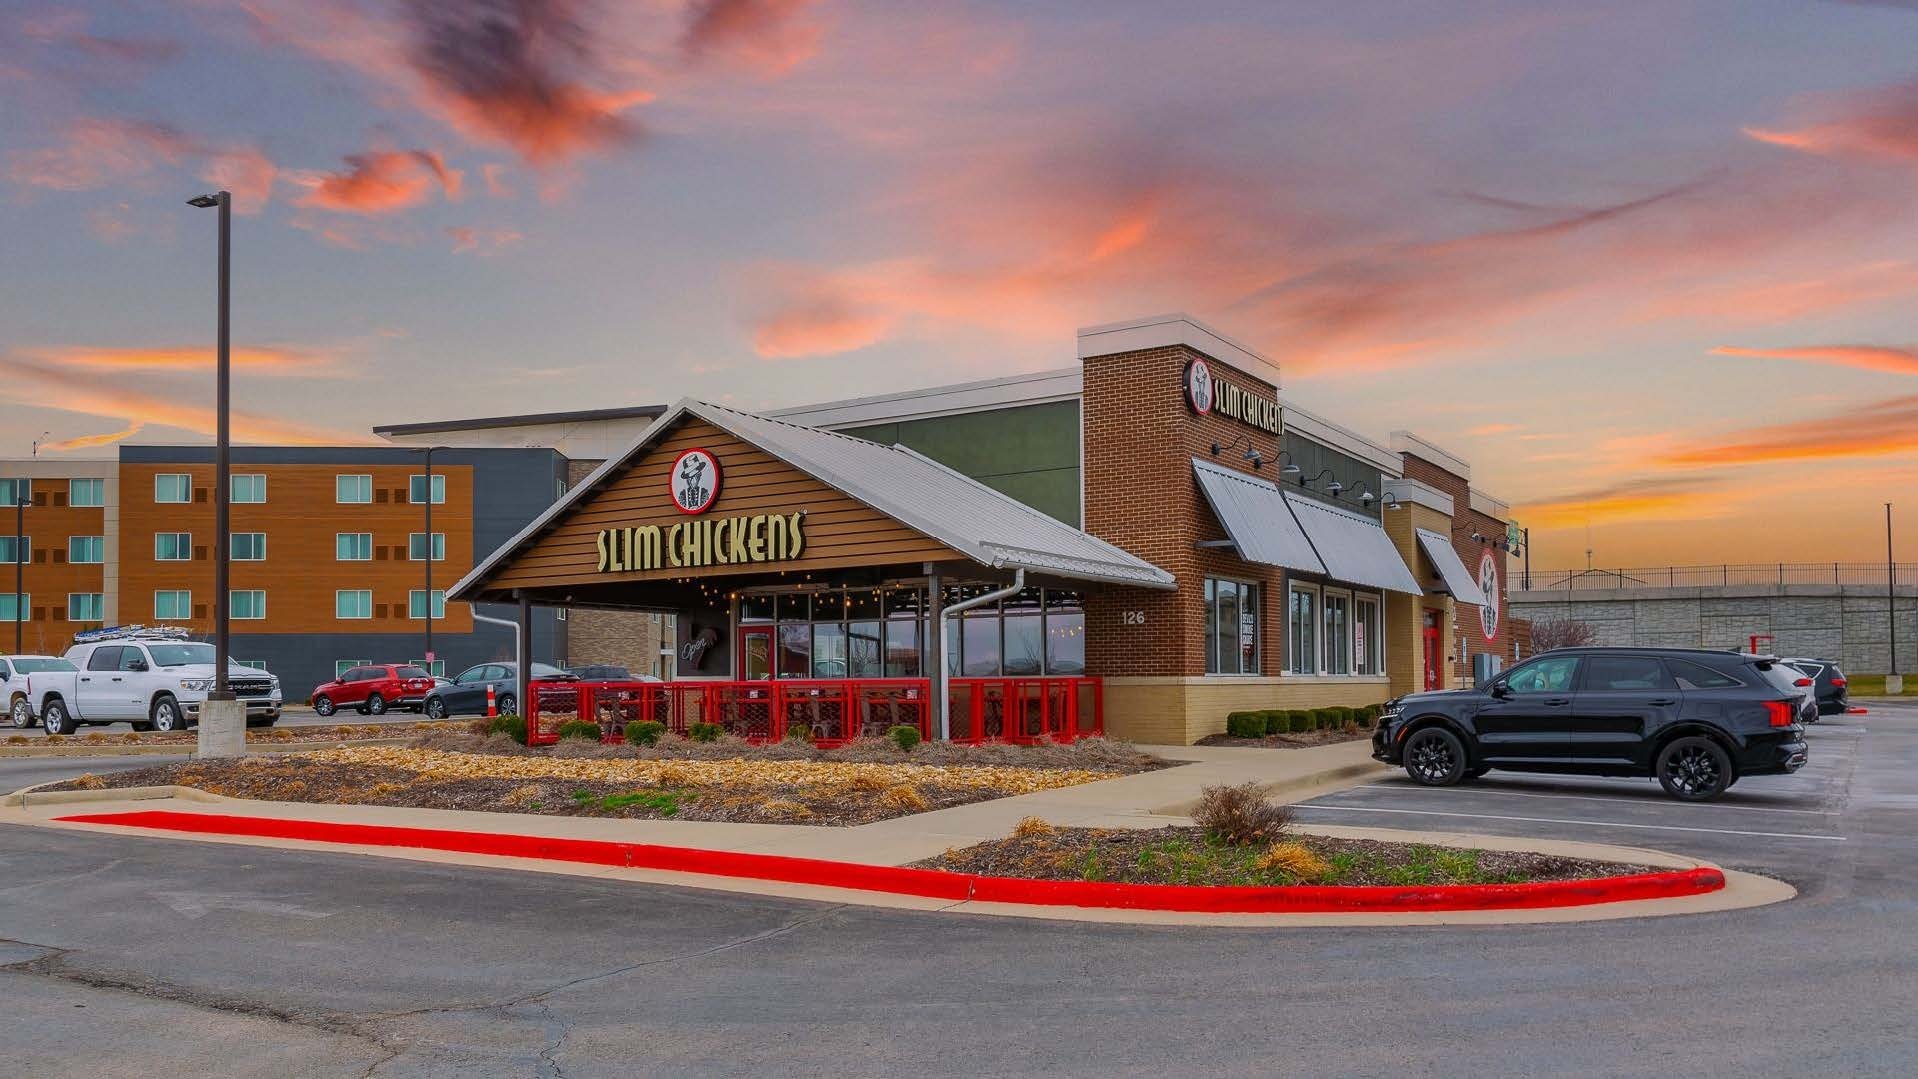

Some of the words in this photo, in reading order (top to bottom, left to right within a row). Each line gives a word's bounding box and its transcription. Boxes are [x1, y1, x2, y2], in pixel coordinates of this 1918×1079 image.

[1215, 379, 1241, 420] SLIM
[1242, 390, 1285, 436] CHICKENS
[597, 524, 662, 572] SLIM
[668, 511, 802, 567] CHICKENS
[1122, 611, 1145, 624] 126
[681, 638, 707, 660] Open
